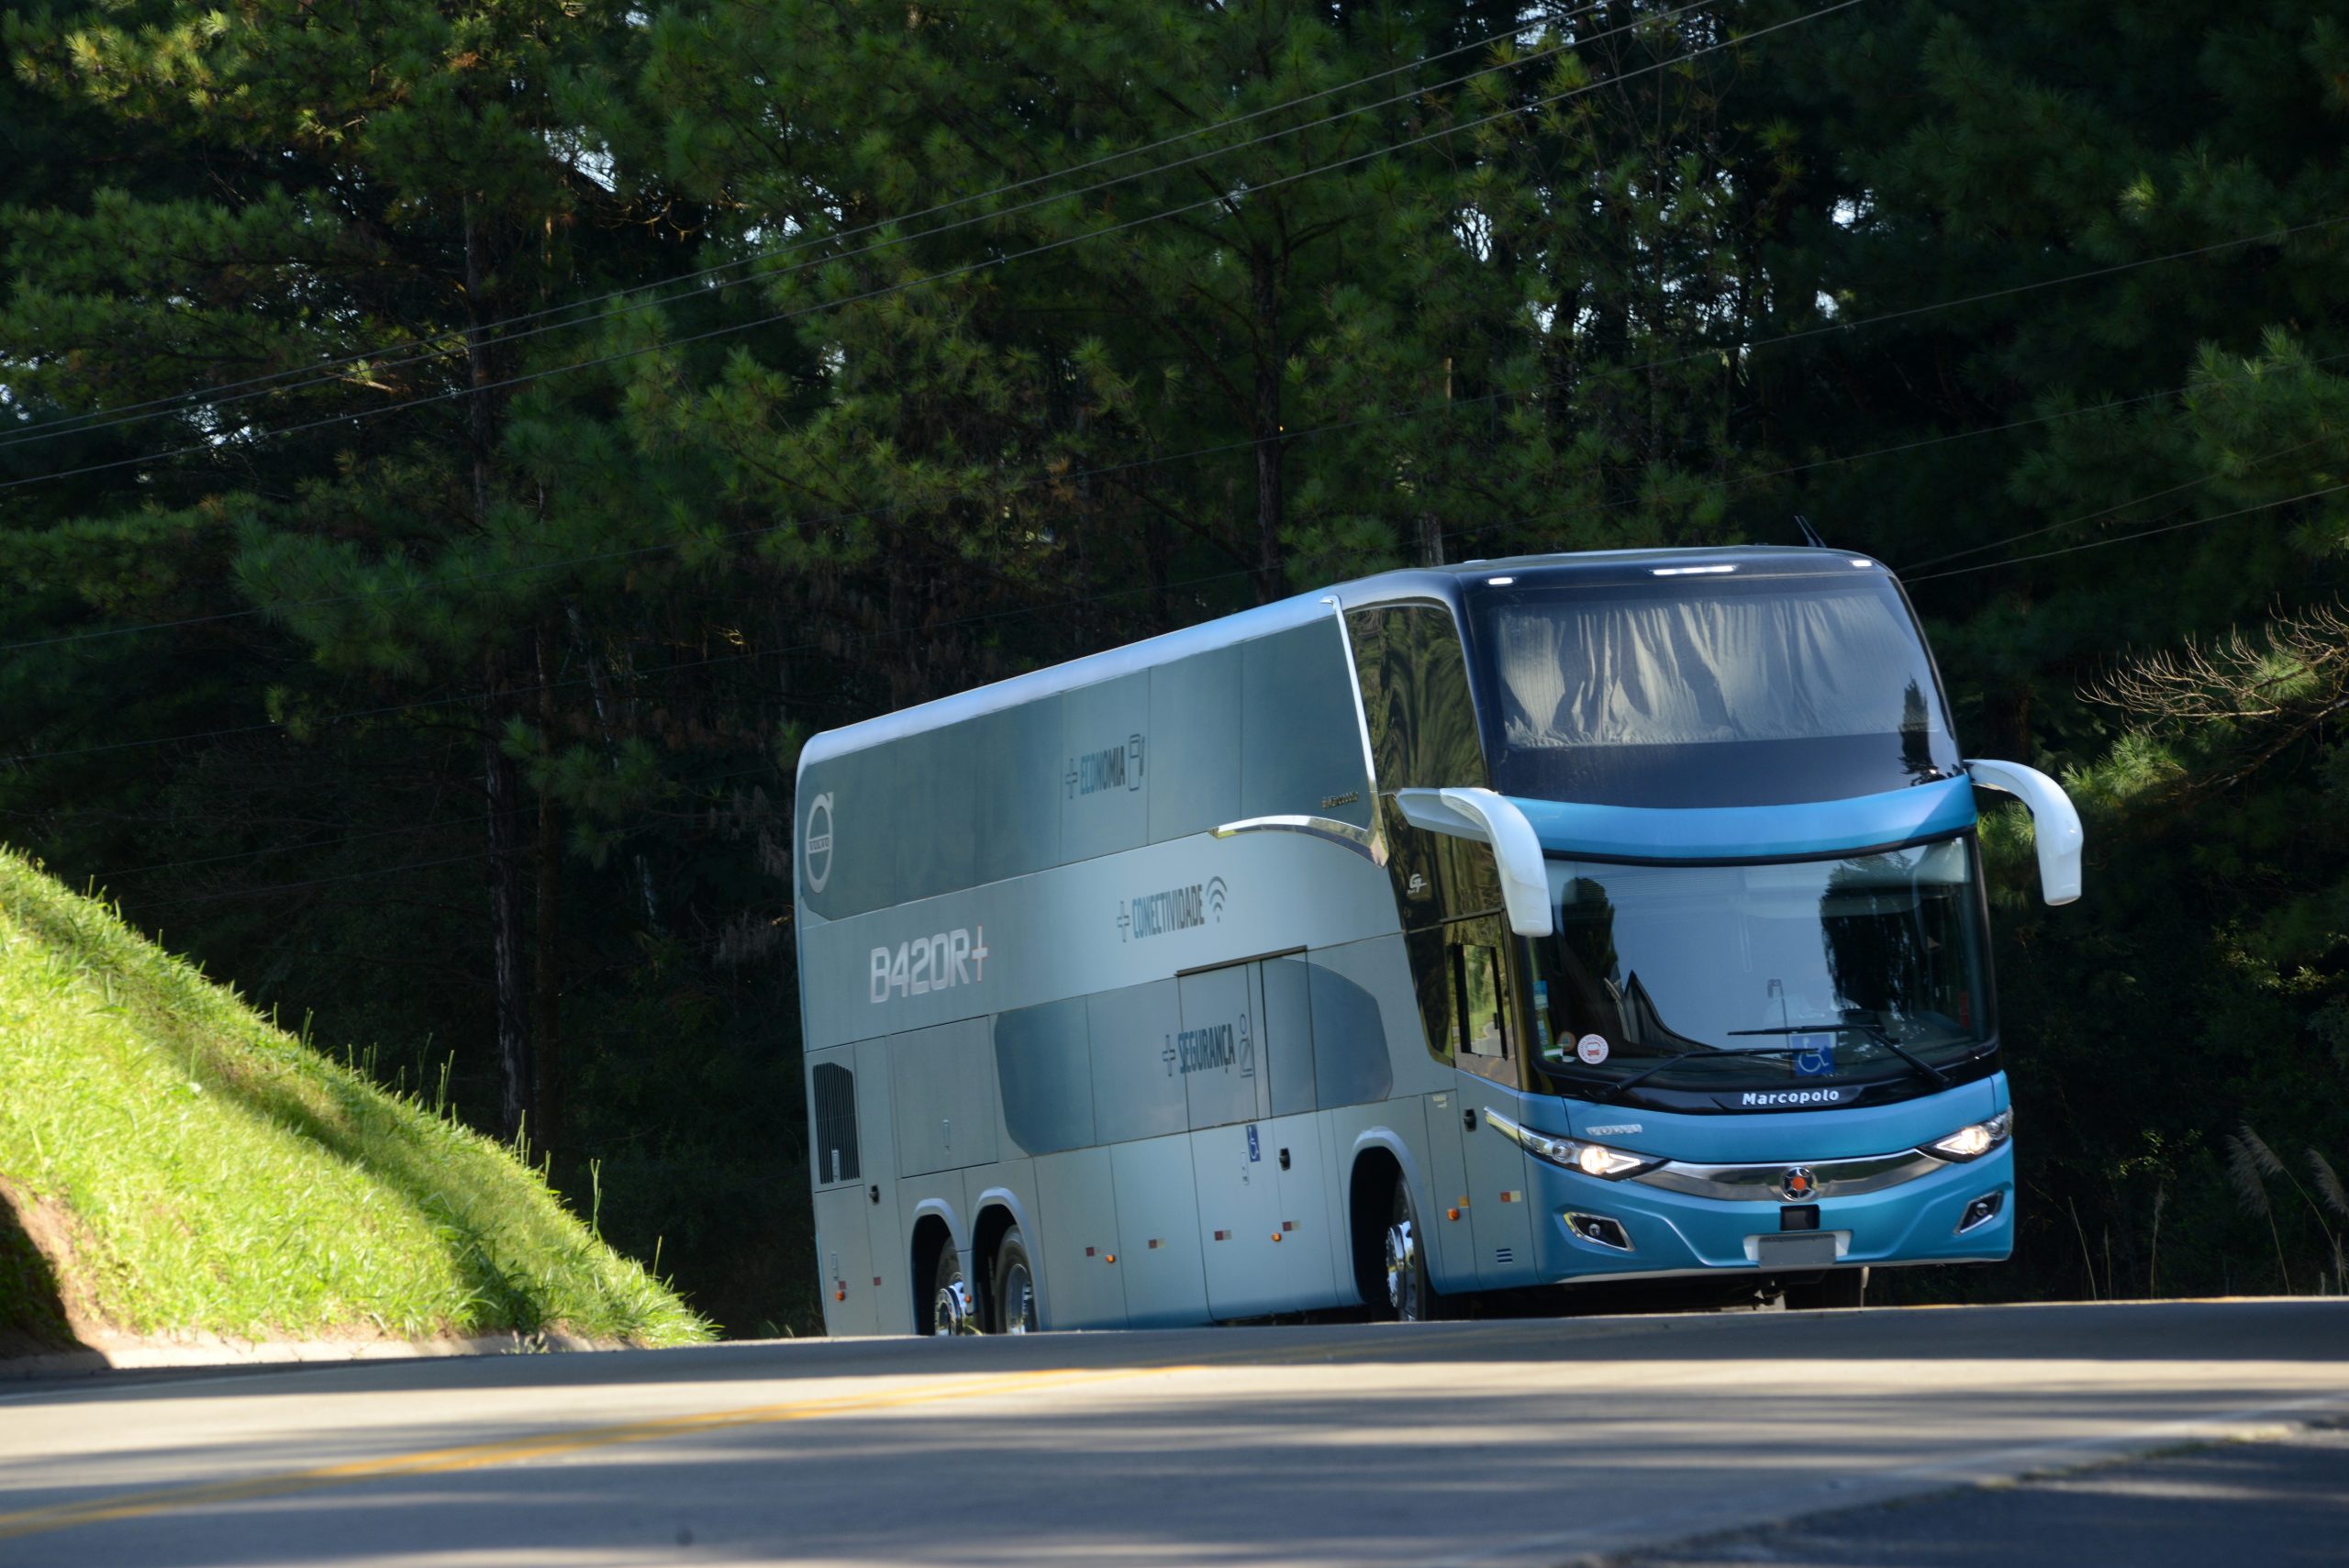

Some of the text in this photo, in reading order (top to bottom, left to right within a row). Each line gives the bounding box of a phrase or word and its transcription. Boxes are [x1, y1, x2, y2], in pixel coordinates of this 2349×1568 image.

[1081, 745, 1126, 795] ECONOMIA
[1132, 884, 1205, 939] CONECTIVIDADE
[1177, 1023, 1236, 1074] SEGURANÇA
[1742, 1089, 1840, 1106] Marcopolo
